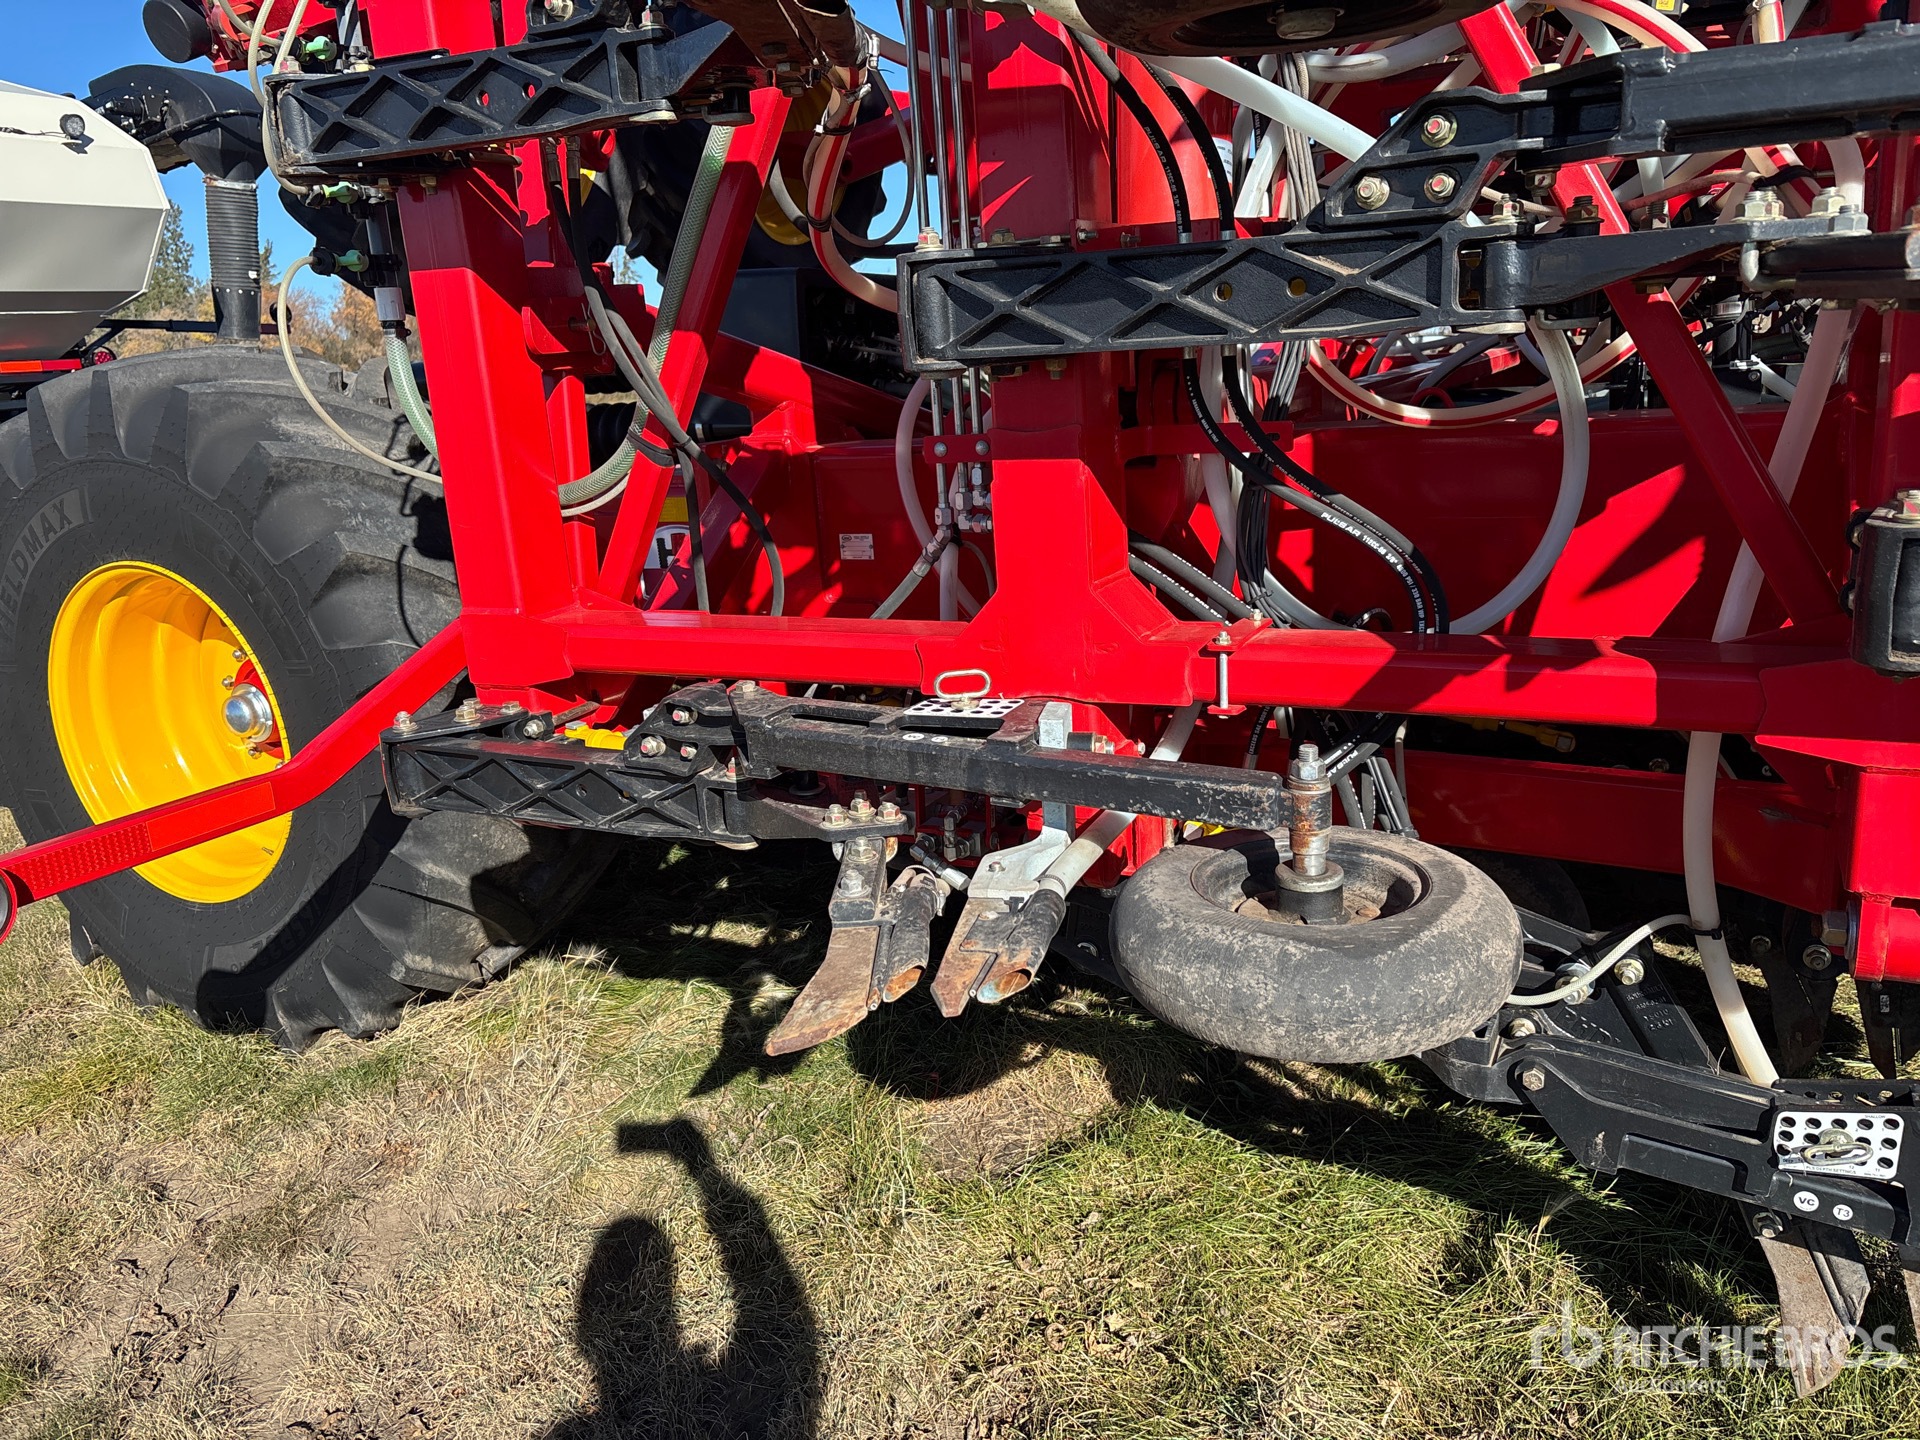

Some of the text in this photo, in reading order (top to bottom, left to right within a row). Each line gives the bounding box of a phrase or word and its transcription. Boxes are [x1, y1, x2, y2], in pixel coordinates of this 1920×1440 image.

[1144, 126, 1167, 163] PULSAR
[1320, 511, 1362, 537] PULSAR
[1798, 1196, 1816, 1206] VC
[1836, 1207, 1851, 1218] T3
